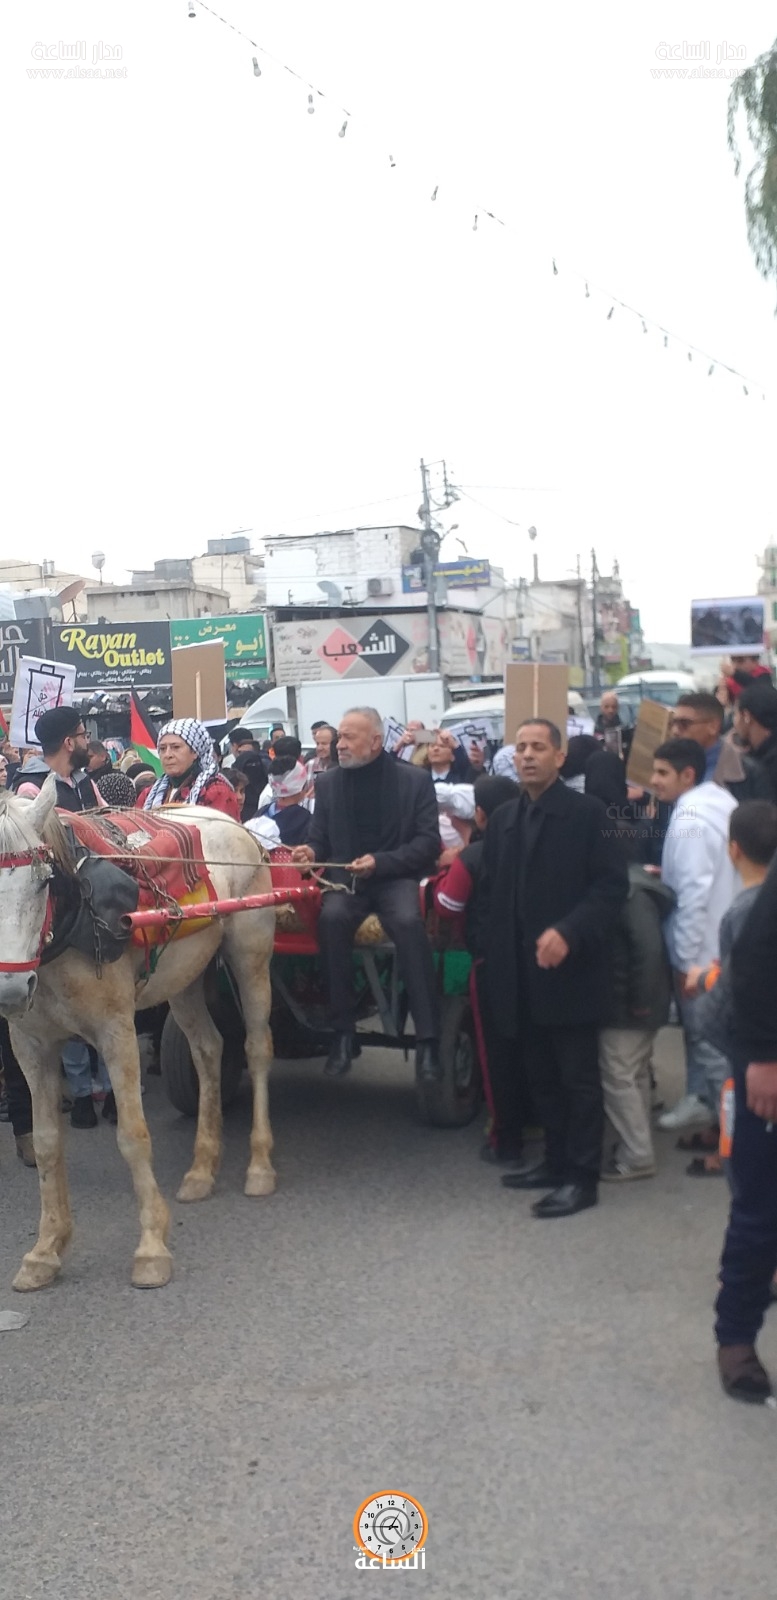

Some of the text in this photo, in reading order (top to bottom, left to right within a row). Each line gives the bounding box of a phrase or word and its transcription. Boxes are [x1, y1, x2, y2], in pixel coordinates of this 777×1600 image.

[198, 620, 237, 636] معرض
[60, 628, 137, 660] Rayan
[234, 629, 264, 656] أبو
[323, 632, 396, 661] الشعب
[104, 648, 165, 668] Outlet
